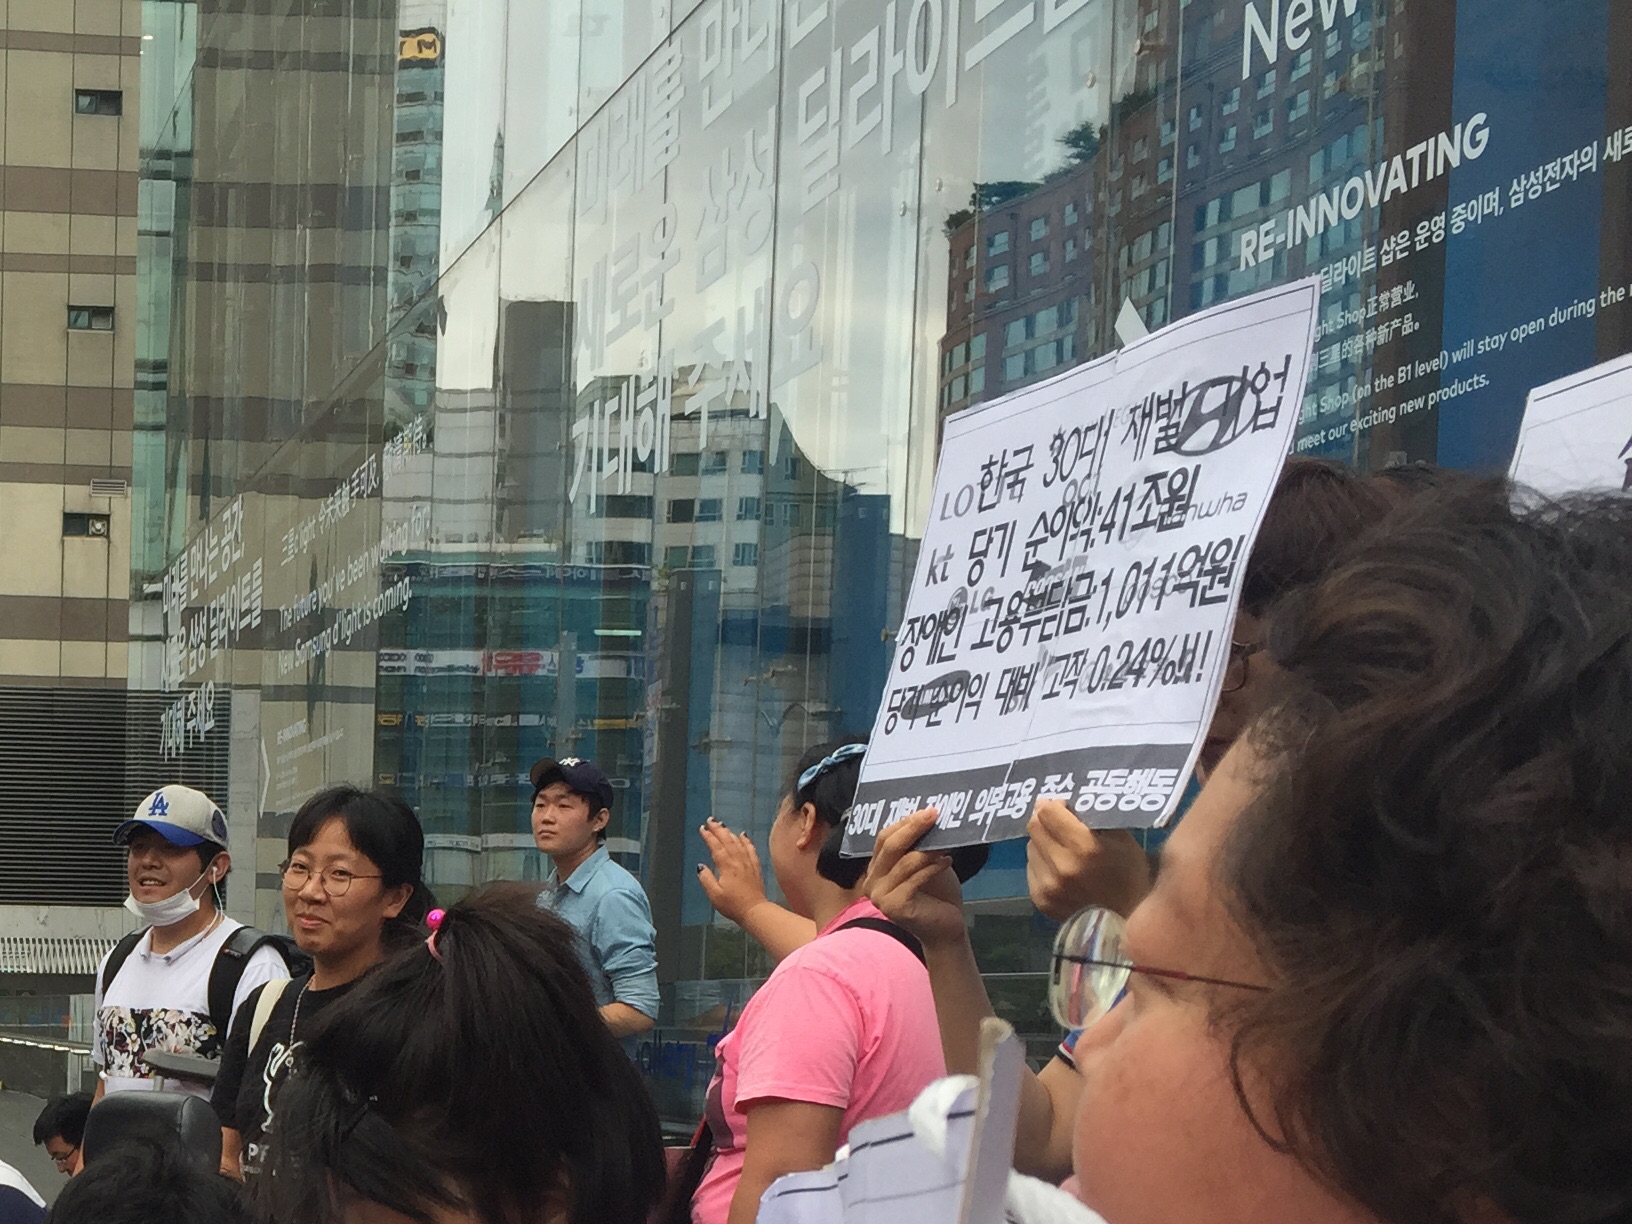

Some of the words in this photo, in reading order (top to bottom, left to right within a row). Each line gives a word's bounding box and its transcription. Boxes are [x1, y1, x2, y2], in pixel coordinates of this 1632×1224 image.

[1242, 0, 1359, 81] New
[1239, 112, 1490, 272] RE-INNOVATING
[1508, 141, 1598, 209] 삼성전자의
[1319, 390, 1350, 416] Shop
[1374, 367, 1395, 394] the
[1397, 362, 1413, 386] B1
[1415, 350, 1449, 380] level)
[1451, 337, 1475, 364] will
[1477, 330, 1508, 357] stay
[1510, 316, 1545, 344] open
[1548, 296, 1597, 328] during
[1599, 284, 1626, 309] the
[1297, 425, 1327, 453] meet
[1328, 420, 1349, 441] our
[1349, 400, 1397, 433] exciting
[1399, 396, 1426, 417] new
[1428, 371, 1490, 411] products.
[977, 443, 1035, 514] 한국
[1042, 408, 1116, 488] 30대
[347, 550, 369, 586] been
[967, 519, 1017, 588] 당기
[294, 626, 332, 668] Samsung
[372, 573, 413, 620] coming.
[899, 605, 969, 673] 장애인
[148, 790, 169, 817] LA
[1075, 768, 1180, 813] 공동행동
